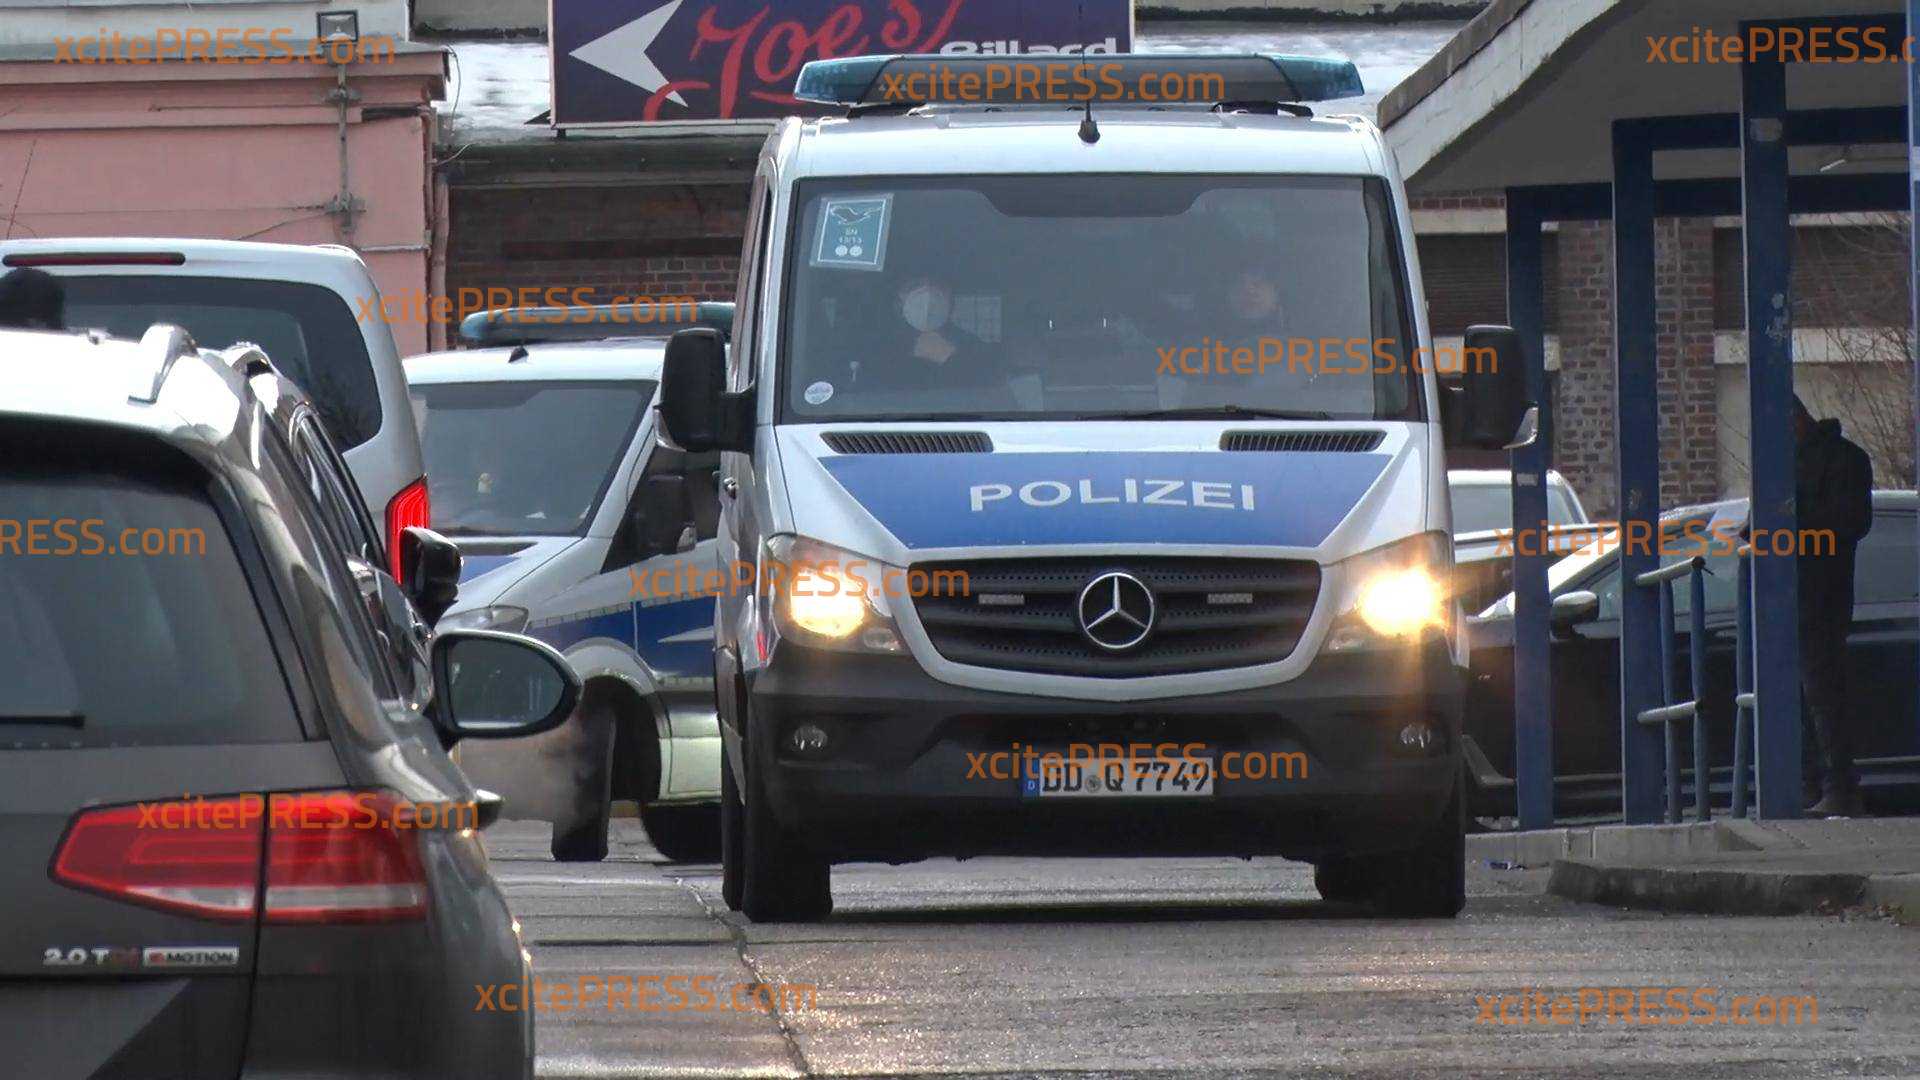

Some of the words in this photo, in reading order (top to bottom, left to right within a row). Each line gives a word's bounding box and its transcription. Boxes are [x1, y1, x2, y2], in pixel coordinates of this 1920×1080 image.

[969, 478, 1255, 512] POLIZEI
[1043, 762, 1083, 792] DD
[1104, 763, 1124, 792] Q
[1134, 762, 1210, 792] 7749
